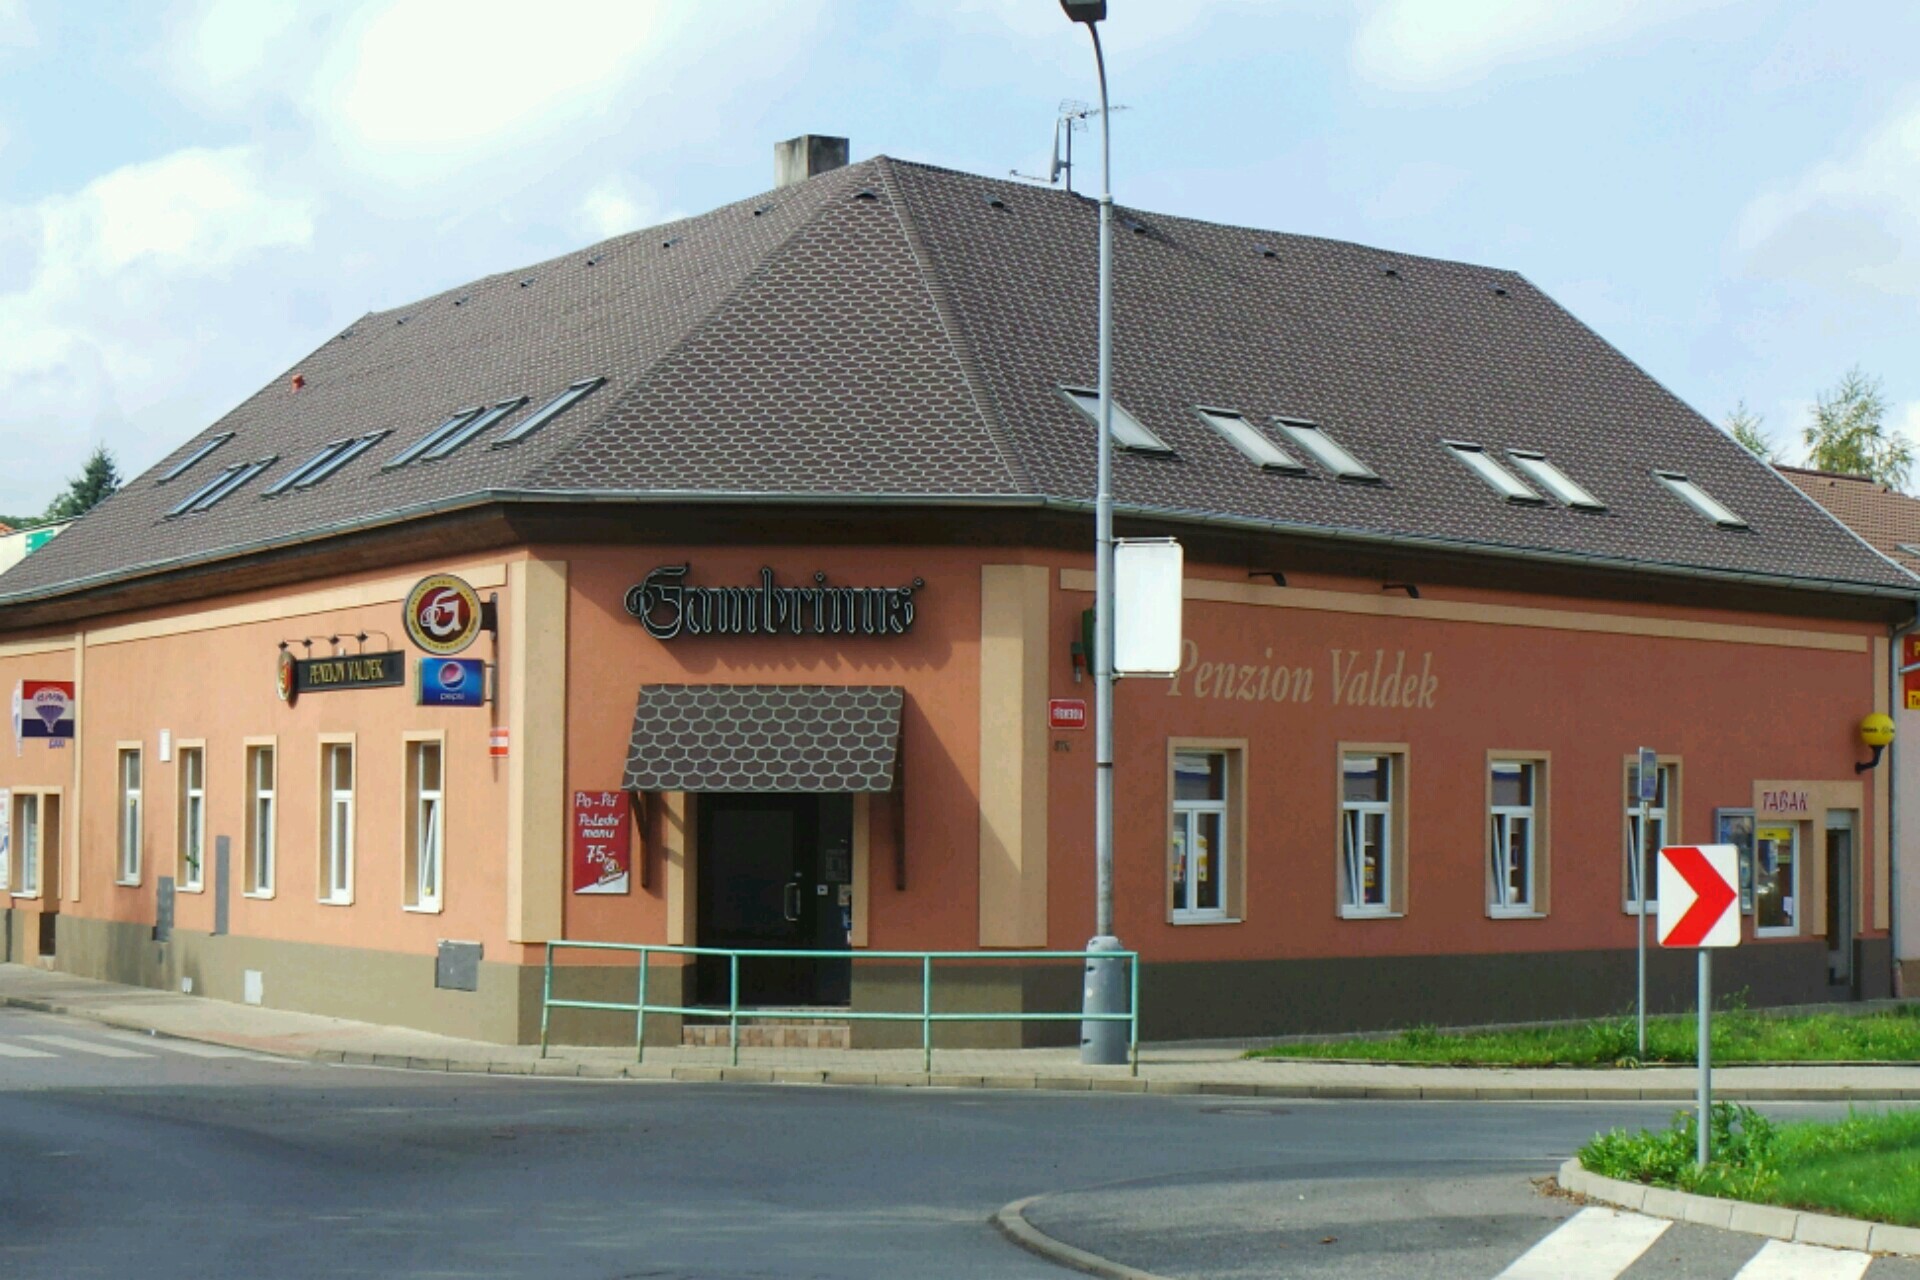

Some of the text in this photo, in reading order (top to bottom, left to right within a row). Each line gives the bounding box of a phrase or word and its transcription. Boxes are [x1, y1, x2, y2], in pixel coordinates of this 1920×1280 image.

[624, 564, 914, 639] Gambrinus
[347, 659, 384, 681] VALDEK
[1166, 638, 1439, 709] Penzion Valdek
[440, 693, 465, 702] pepsi
